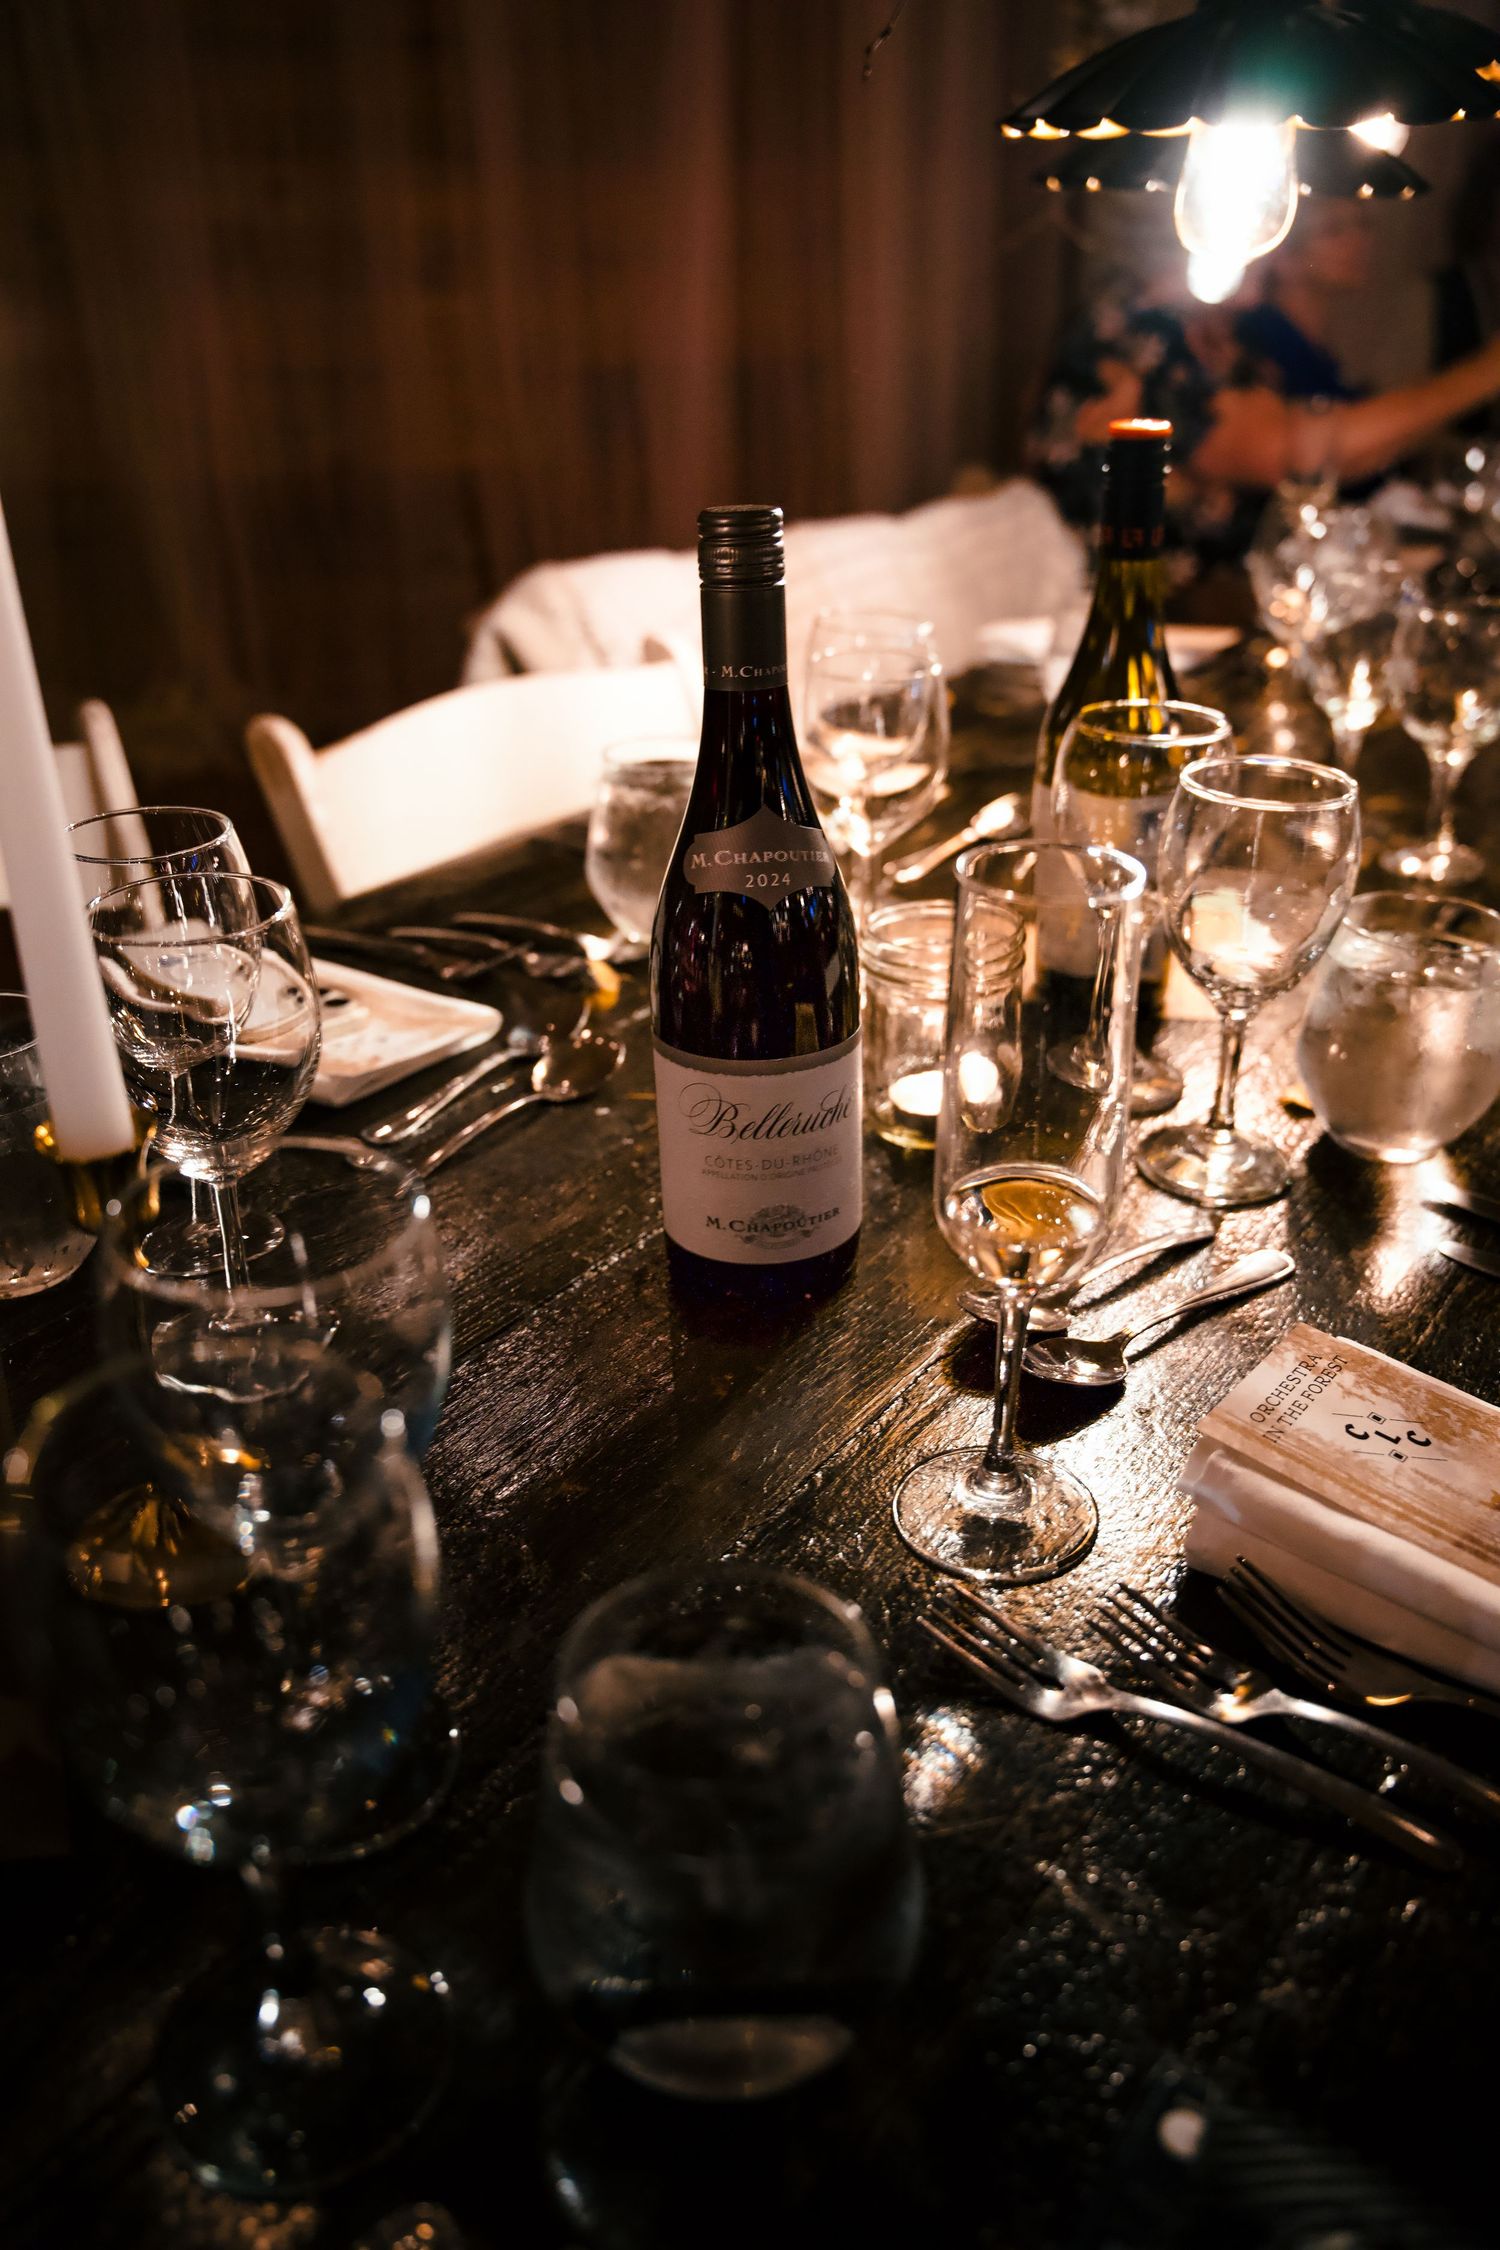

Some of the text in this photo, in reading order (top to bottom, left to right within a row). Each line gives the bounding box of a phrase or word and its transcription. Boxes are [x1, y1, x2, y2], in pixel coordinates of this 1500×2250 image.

[745, 873, 791, 888] 2024
[1249, 1354, 1323, 1423] ORCHESTRA
[1262, 1354, 1349, 1444] IN THE FOREST
